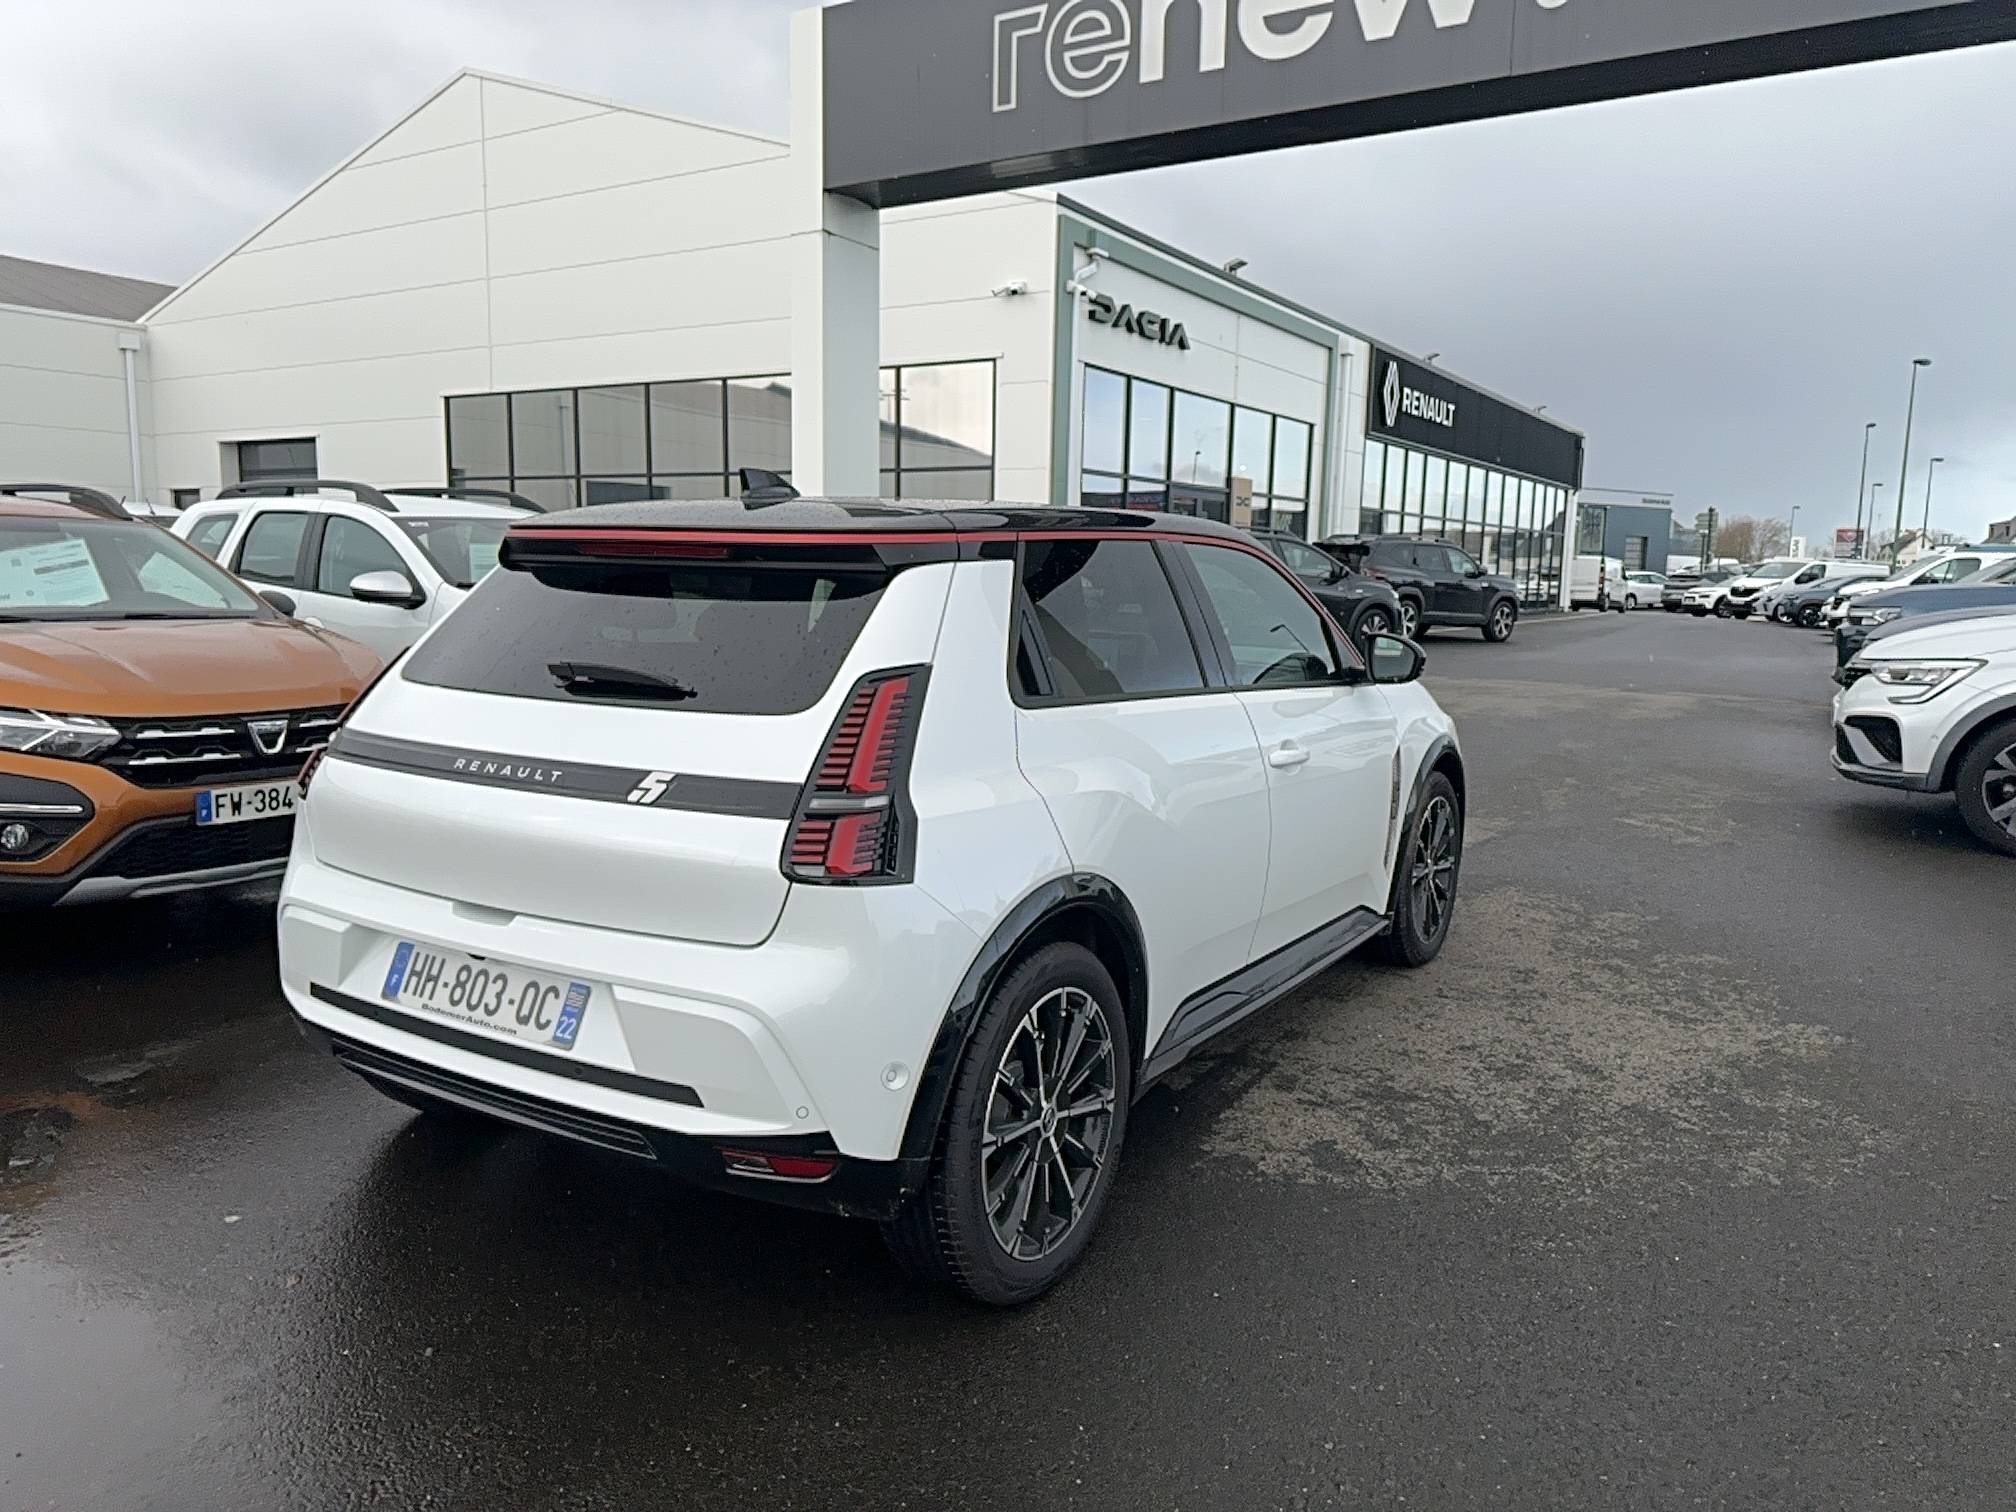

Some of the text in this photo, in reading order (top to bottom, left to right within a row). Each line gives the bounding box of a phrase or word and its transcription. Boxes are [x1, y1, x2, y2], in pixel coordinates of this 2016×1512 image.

[1087, 293, 1191, 351] DACIA
[1402, 386, 1456, 428] RENAULT
[453, 758, 563, 783] RENAULT
[403, 951, 560, 1031] HH-803-QC
[555, 1016, 577, 1039] 22
